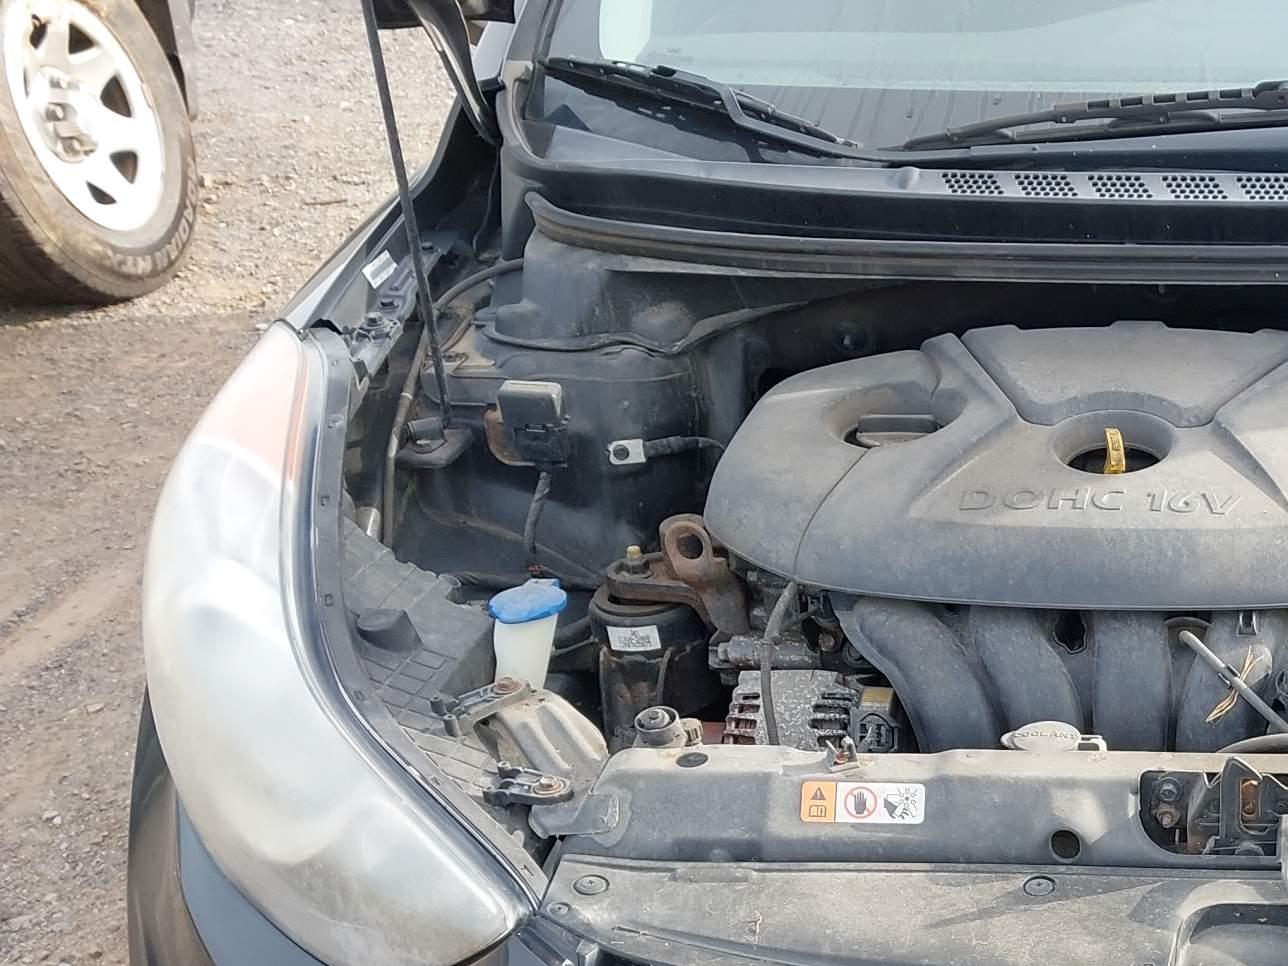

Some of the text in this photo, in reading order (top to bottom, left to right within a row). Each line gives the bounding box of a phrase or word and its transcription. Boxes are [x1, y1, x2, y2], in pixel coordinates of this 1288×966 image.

[959, 486, 1241, 516] DOHC 16V
[1013, 730, 1079, 740] COOLANT
